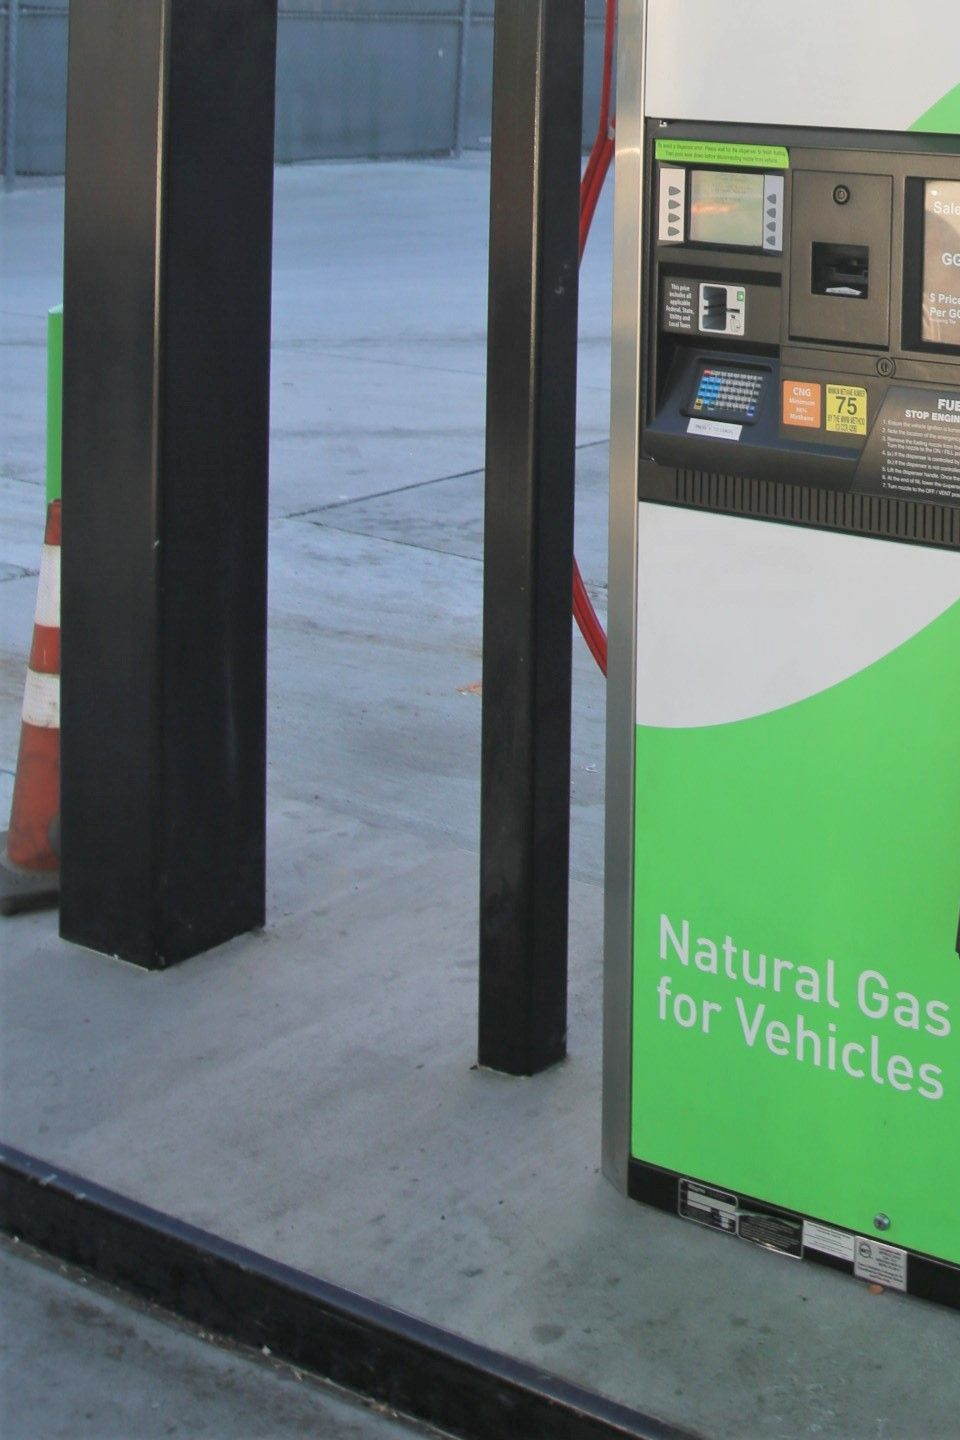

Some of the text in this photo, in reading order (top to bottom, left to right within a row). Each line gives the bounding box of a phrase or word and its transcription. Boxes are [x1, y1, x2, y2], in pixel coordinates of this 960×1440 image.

[934, 201, 960, 215] Sale
[930, 293, 935, 302] $
[930, 307, 946, 317] Per
[793, 387, 811, 397] CNG
[836, 396, 857, 415] 75
[905, 410, 929, 420] STOP
[660, 914, 951, 1037] Natural Gas
[657, 976, 944, 1100] for Vehicles
